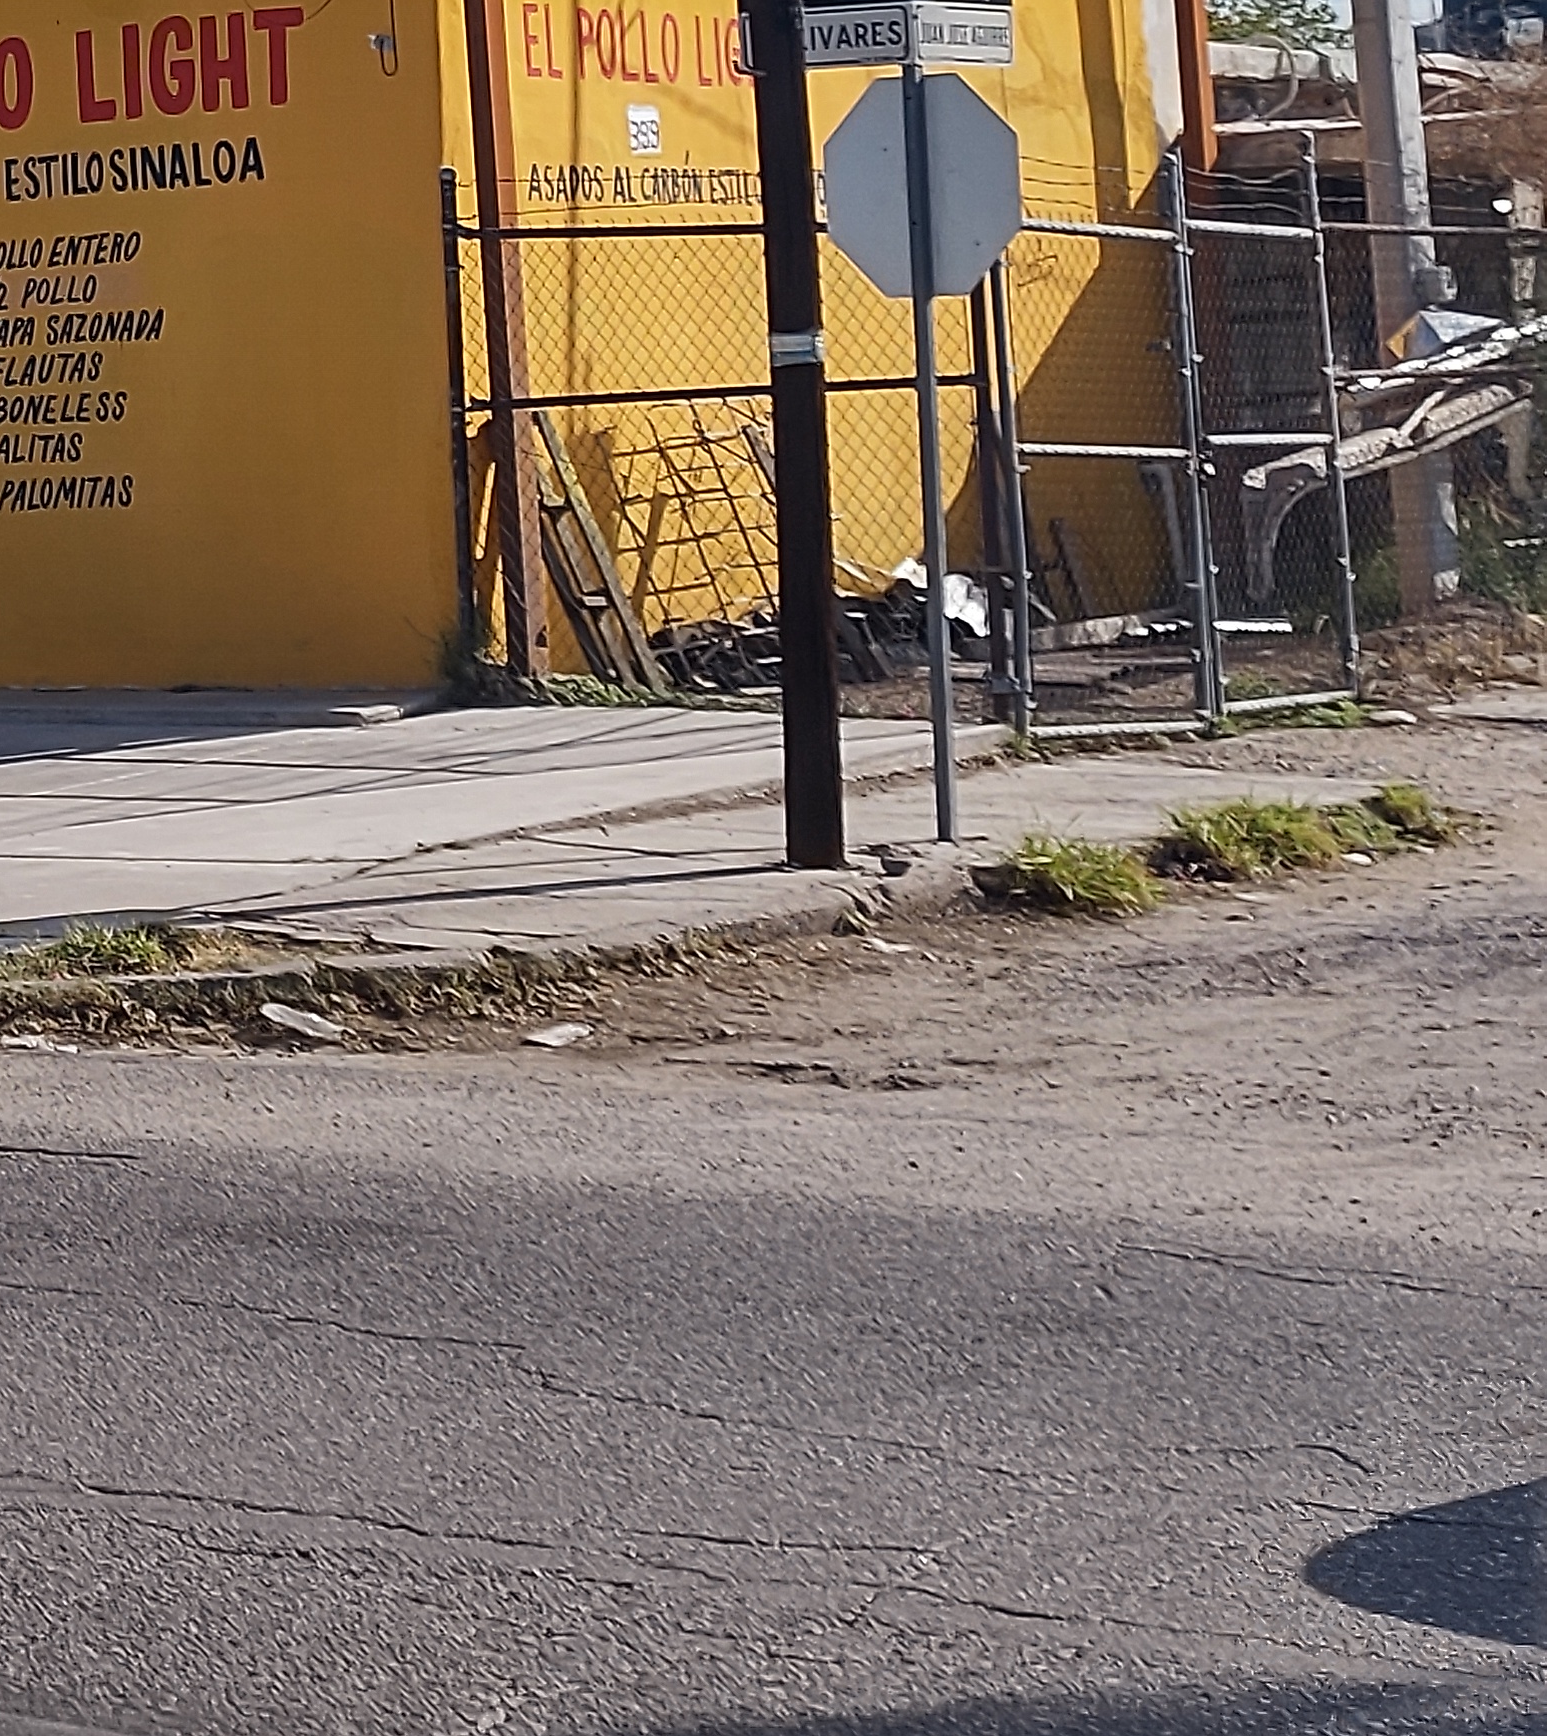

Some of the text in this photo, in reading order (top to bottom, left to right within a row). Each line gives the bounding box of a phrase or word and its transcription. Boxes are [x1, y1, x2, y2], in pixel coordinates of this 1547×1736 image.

[75, 7, 304, 124] LIGHT
[523, 3, 563, 79] EL
[576, 7, 680, 83] POLLO
[6, 150, 105, 202] ESTILO
[108, 137, 265, 195] SINALOA
[528, 164, 605, 203] ASADOS
[613, 166, 637, 203] AL
[641, 150, 703, 204] CARBÓN
[47, 231, 141, 268] ENTERO
[21, 274, 98, 308] POLLO
[46, 308, 165, 346] SAZONADA
